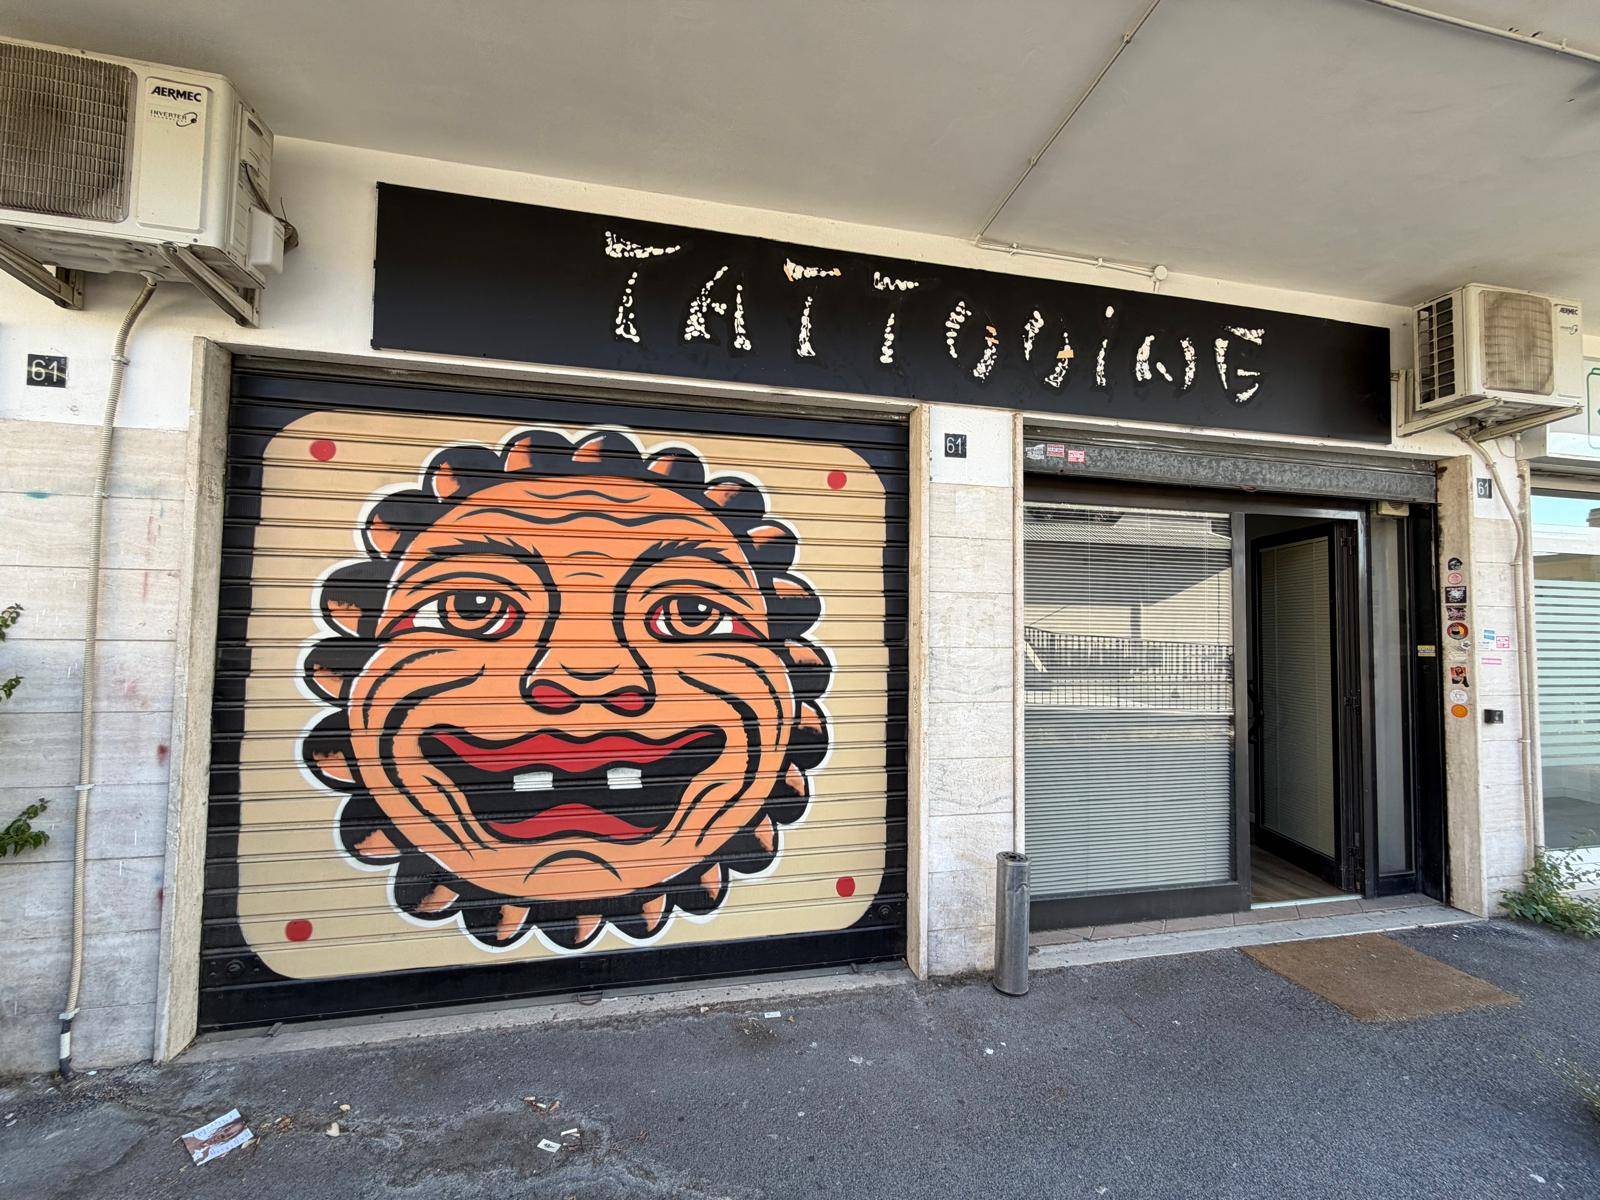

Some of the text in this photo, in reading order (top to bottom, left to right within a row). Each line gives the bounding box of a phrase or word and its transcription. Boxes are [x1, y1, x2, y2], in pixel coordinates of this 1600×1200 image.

[151, 86, 202, 103] AERMEC
[150, 109, 187, 120] INVERTER
[31, 359, 58, 382] 61
[946, 436, 962, 454] 61
[1477, 481, 1489, 496] 61
